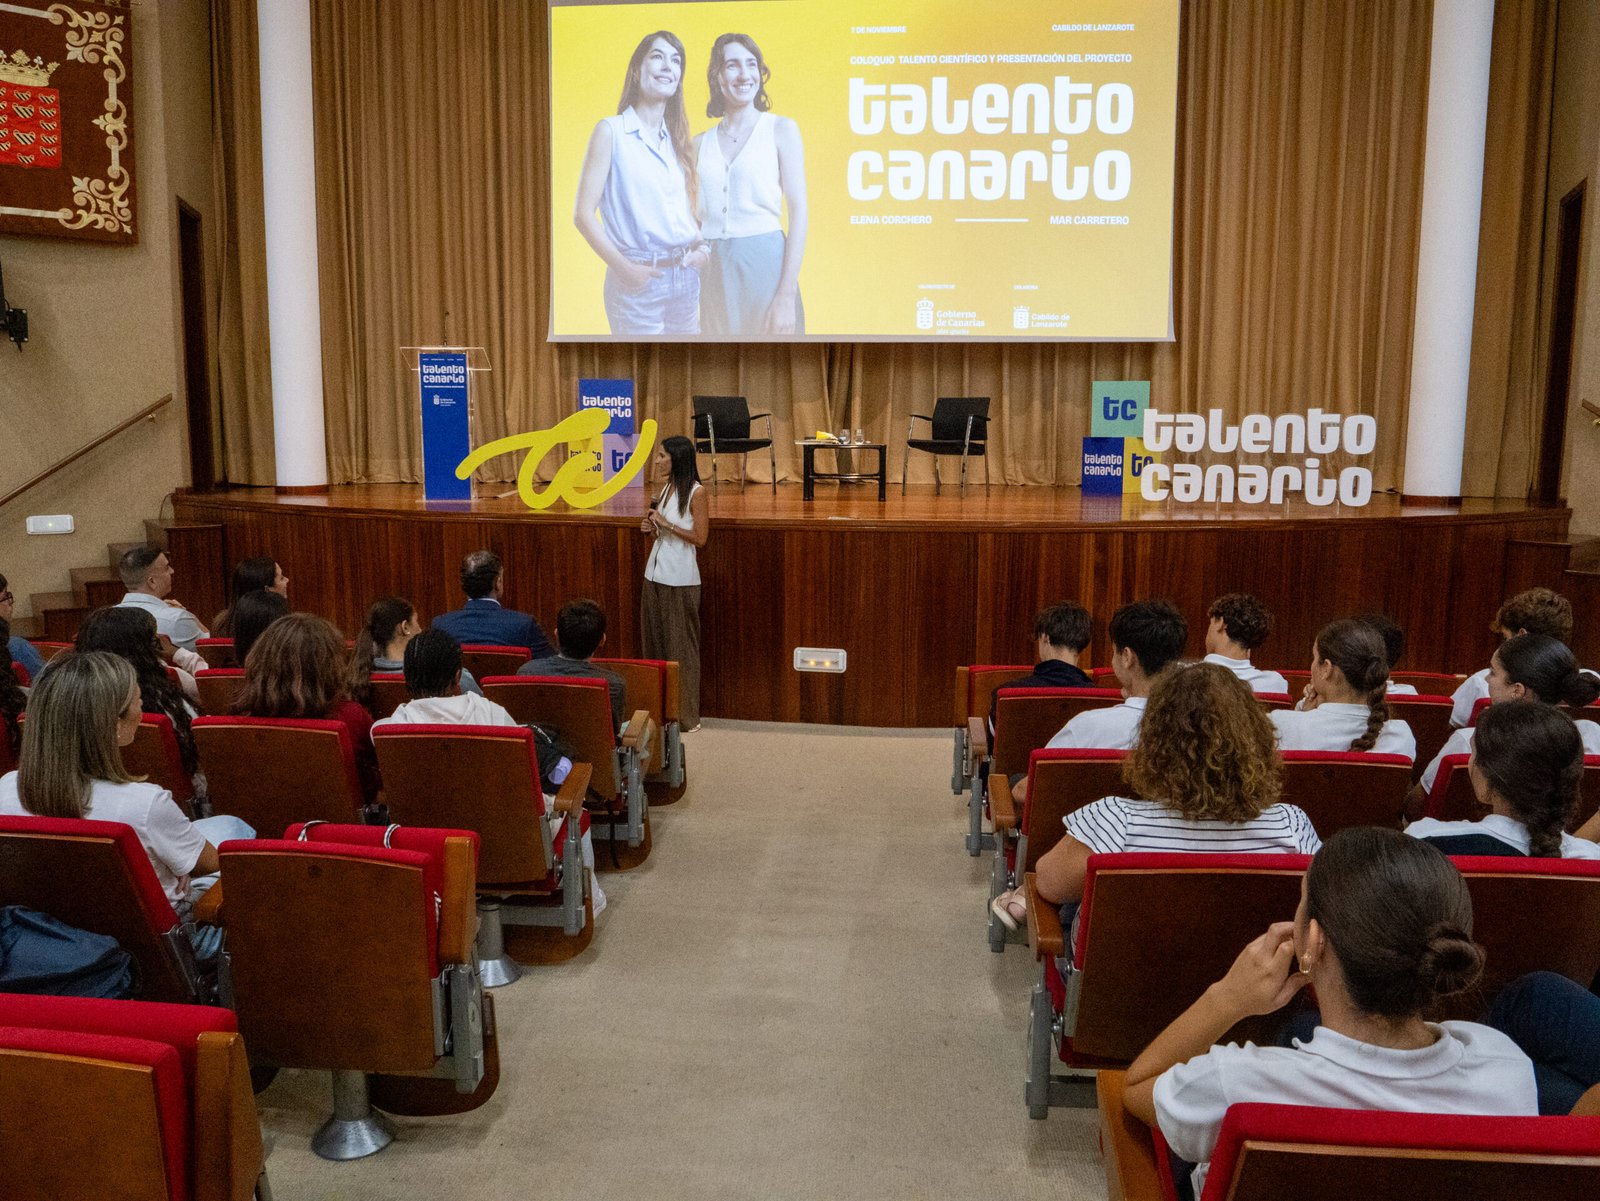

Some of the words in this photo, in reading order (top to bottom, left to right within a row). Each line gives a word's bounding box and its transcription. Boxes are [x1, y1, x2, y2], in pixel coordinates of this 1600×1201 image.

[855, 26, 866, 34] DE
[866, 25, 907, 34] NOVIEMBRE
[1051, 24, 1082, 32] CABILDO
[1093, 23, 1135, 31] LANZAROTE
[849, 55, 896, 67] COLOQUIO
[898, 55, 938, 65] TALENTO
[938, 52, 988, 64] CIENTÍFICO
[989, 54, 996, 64] Y
[997, 52, 1065, 63] PRESENTACIÓN
[1066, 54, 1083, 63] DEL
[1084, 53, 1133, 63] PROYECTO
[848, 75, 1135, 136] talento
[847, 138, 1132, 201] canario
[850, 215, 880, 225] ELENA
[881, 215, 932, 225] CORCHERO
[1050, 215, 1073, 225] MAR
[1074, 215, 1130, 225] CARRETERO
[422, 364, 465, 374] talento
[422, 373, 465, 383] canario
[582, 395, 632, 407] talento
[1103, 396, 1137, 421] tc
[1143, 408, 1376, 455] talento
[1084, 453, 1122, 465] talento
[1084, 465, 1122, 477] canario
[1140, 458, 1373, 507] canario
